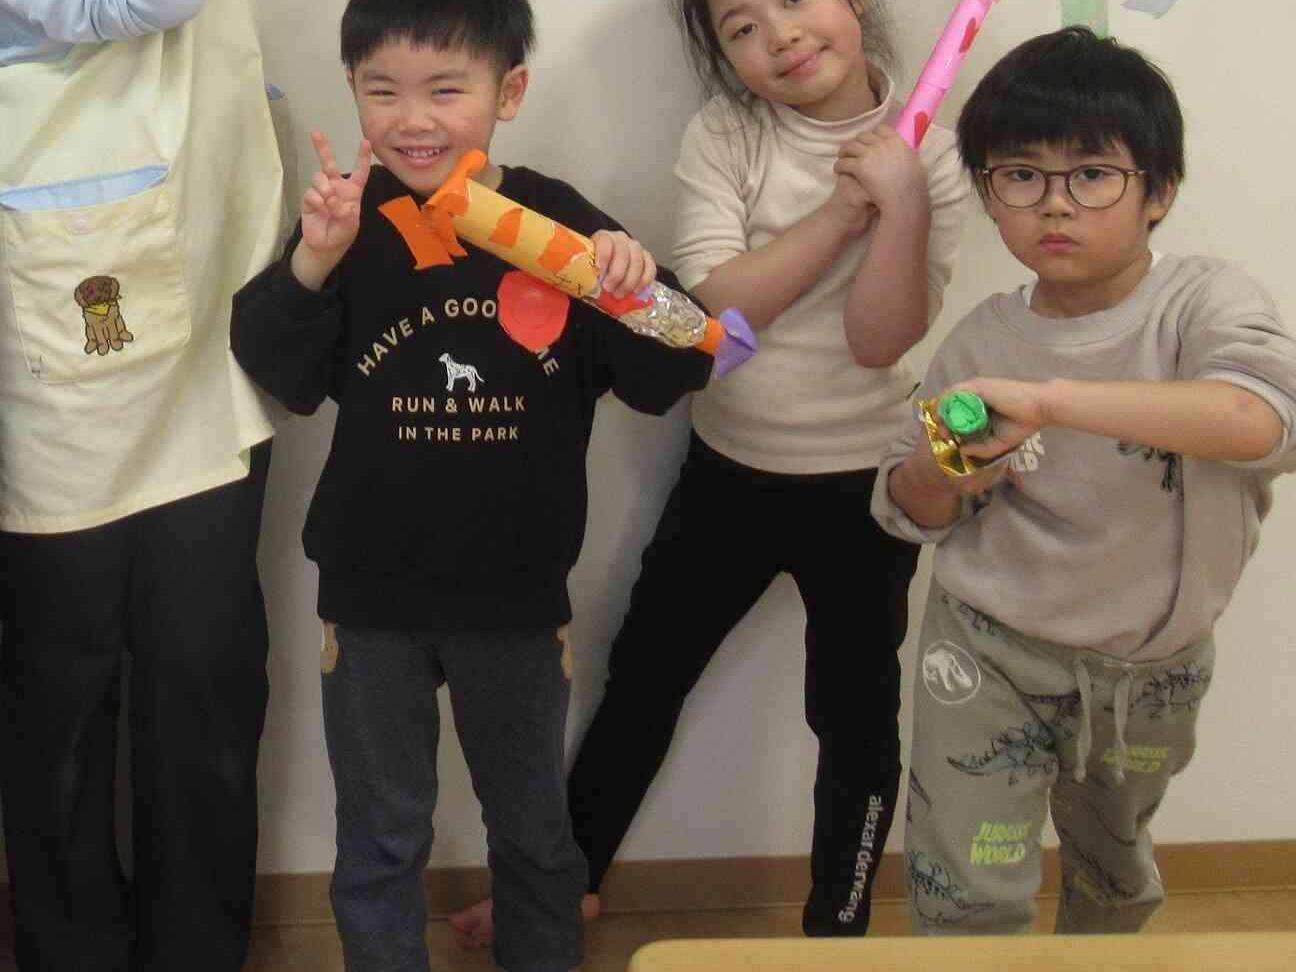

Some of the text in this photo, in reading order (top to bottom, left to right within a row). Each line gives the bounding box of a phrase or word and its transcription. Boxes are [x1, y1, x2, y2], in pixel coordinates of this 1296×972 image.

[357, 297, 498, 377] HAVE A GOO
[392, 396, 526, 414] RUN & WALK
[398, 426, 520, 441] IN THE PARK
